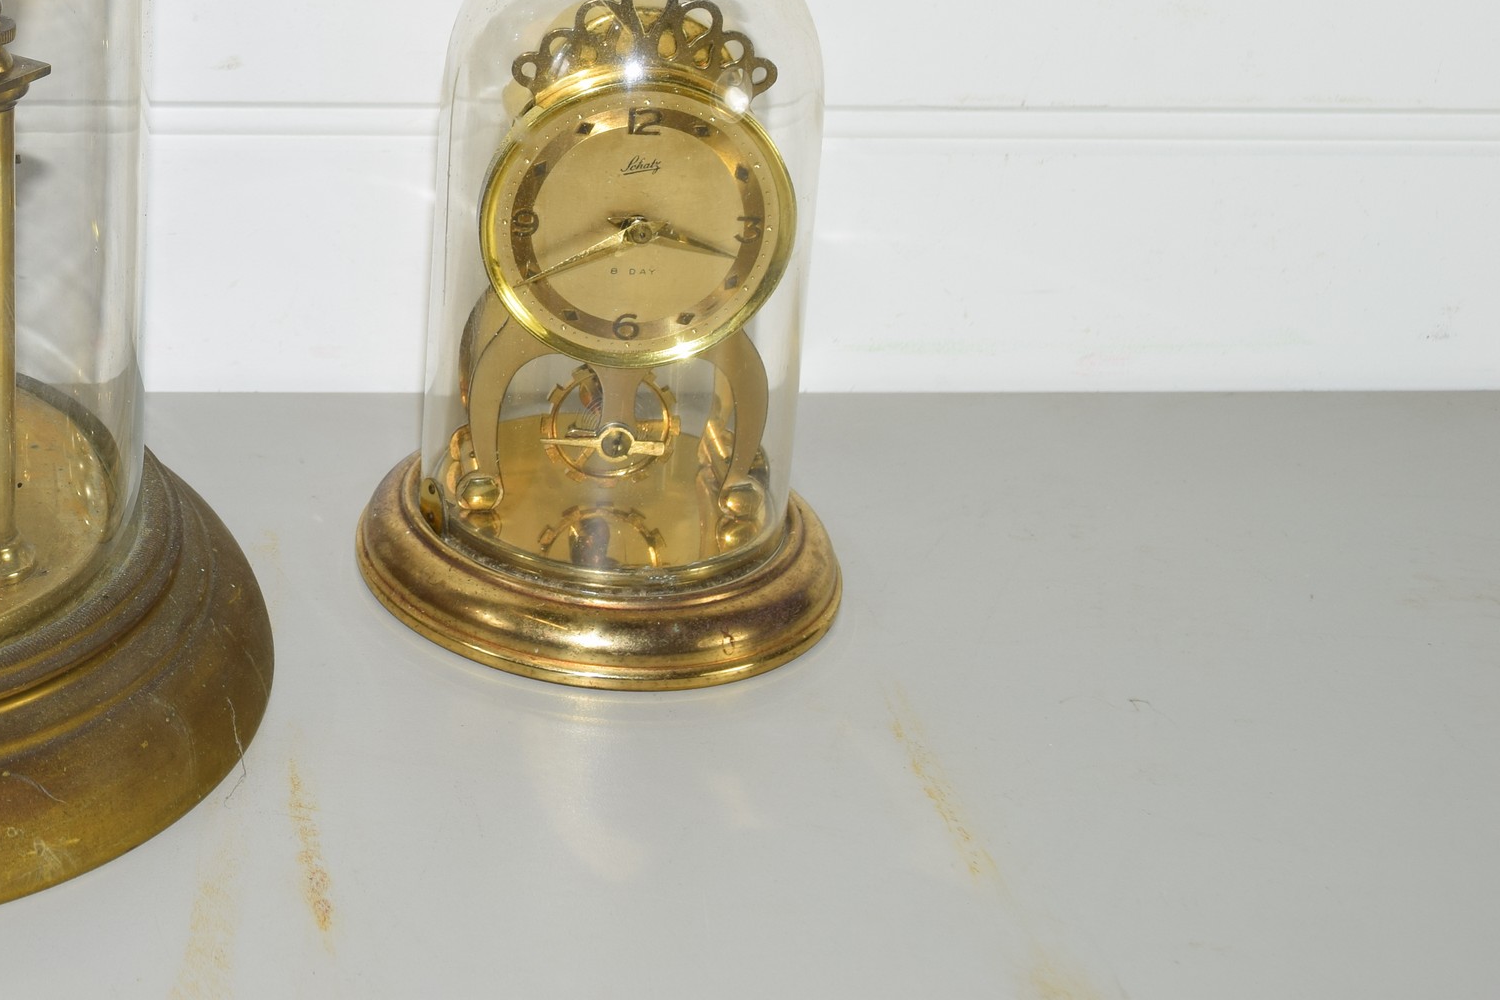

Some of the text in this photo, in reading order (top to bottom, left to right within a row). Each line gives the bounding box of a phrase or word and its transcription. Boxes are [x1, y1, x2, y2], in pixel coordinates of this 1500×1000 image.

[627, 107, 663, 135] 12
[619, 155, 662, 175] Schatz
[512, 209, 540, 237] 9
[734, 216, 762, 243] 3
[628, 267, 656, 275] DAY
[612, 313, 639, 340] 6
